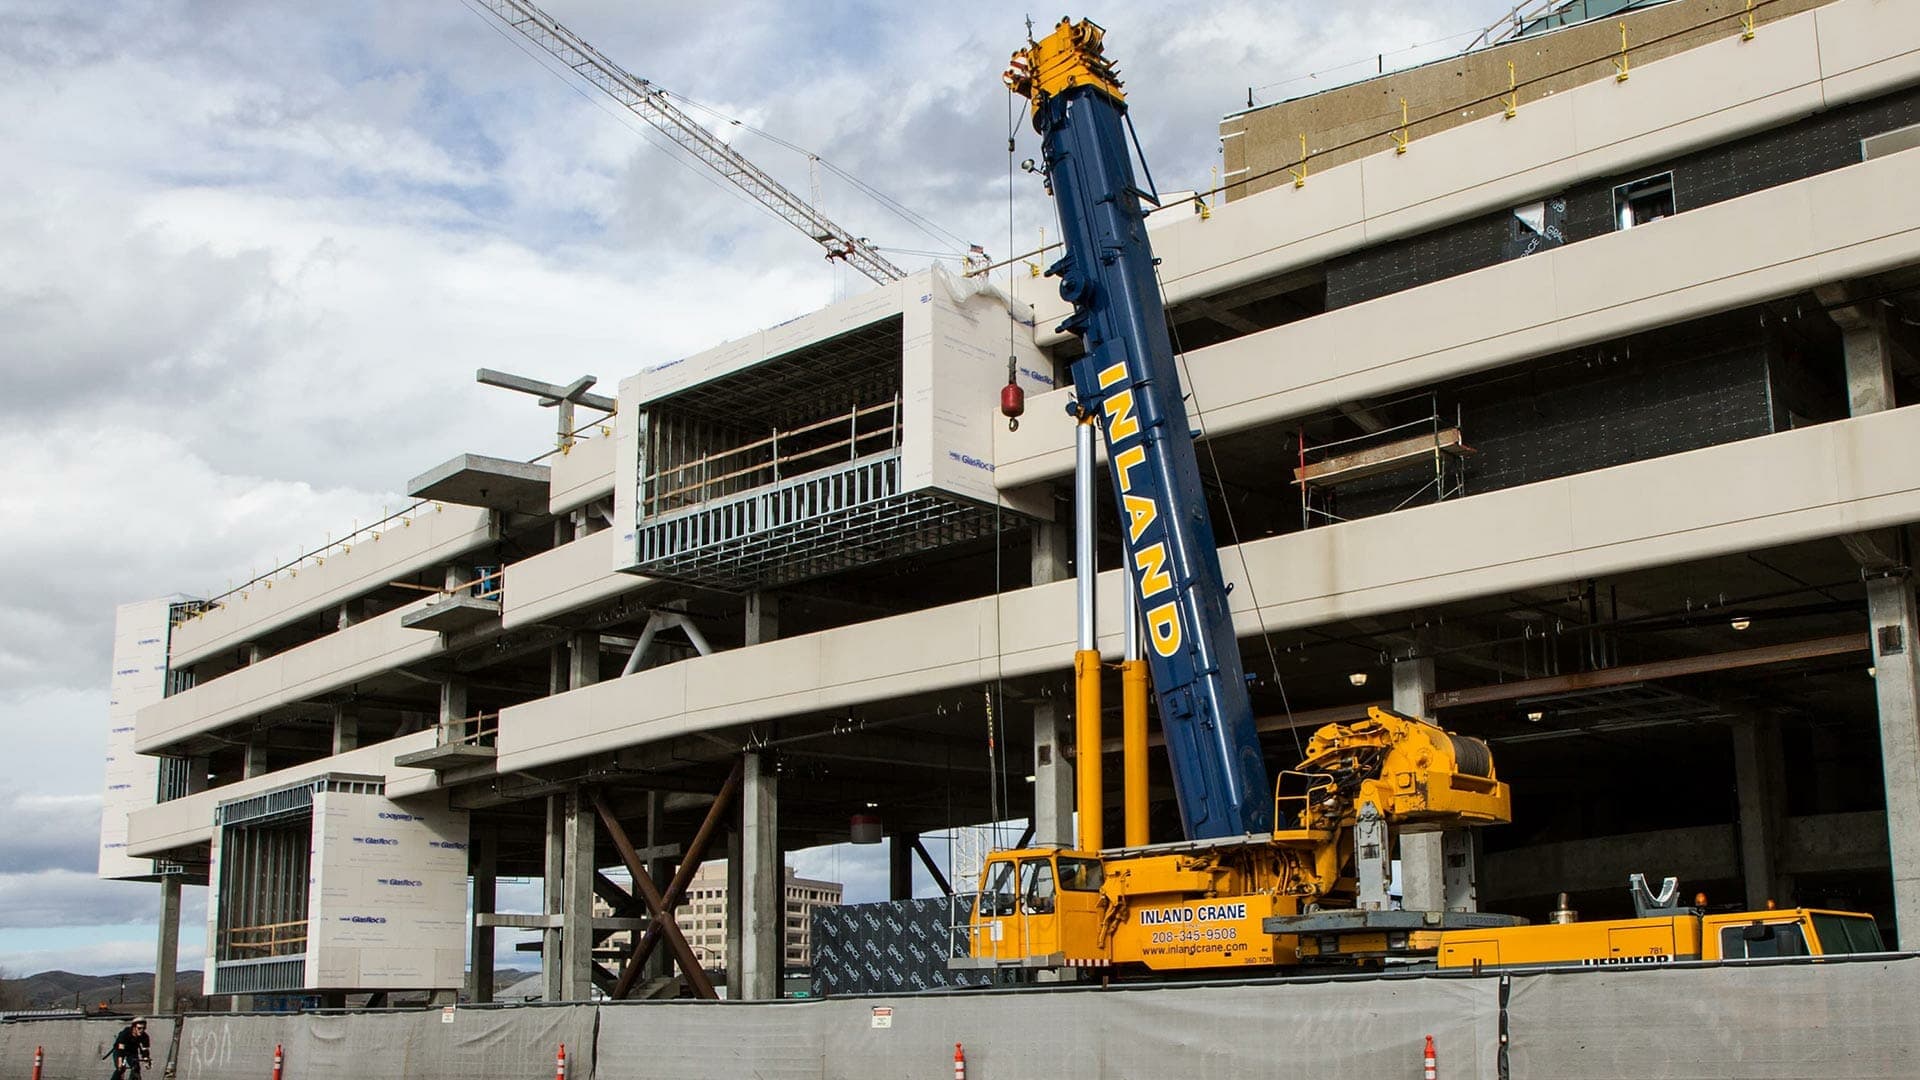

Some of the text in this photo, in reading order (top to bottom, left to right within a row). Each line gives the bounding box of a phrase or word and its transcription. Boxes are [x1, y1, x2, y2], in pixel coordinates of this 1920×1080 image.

[1097, 361, 1182, 657] INLAND
[1140, 908, 1194, 925] INLAND
[1197, 904, 1246, 921] CRANE
[1152, 928, 1237, 943] 208-345-9508
[1142, 942, 1248, 956] www.inlandcrane.com
